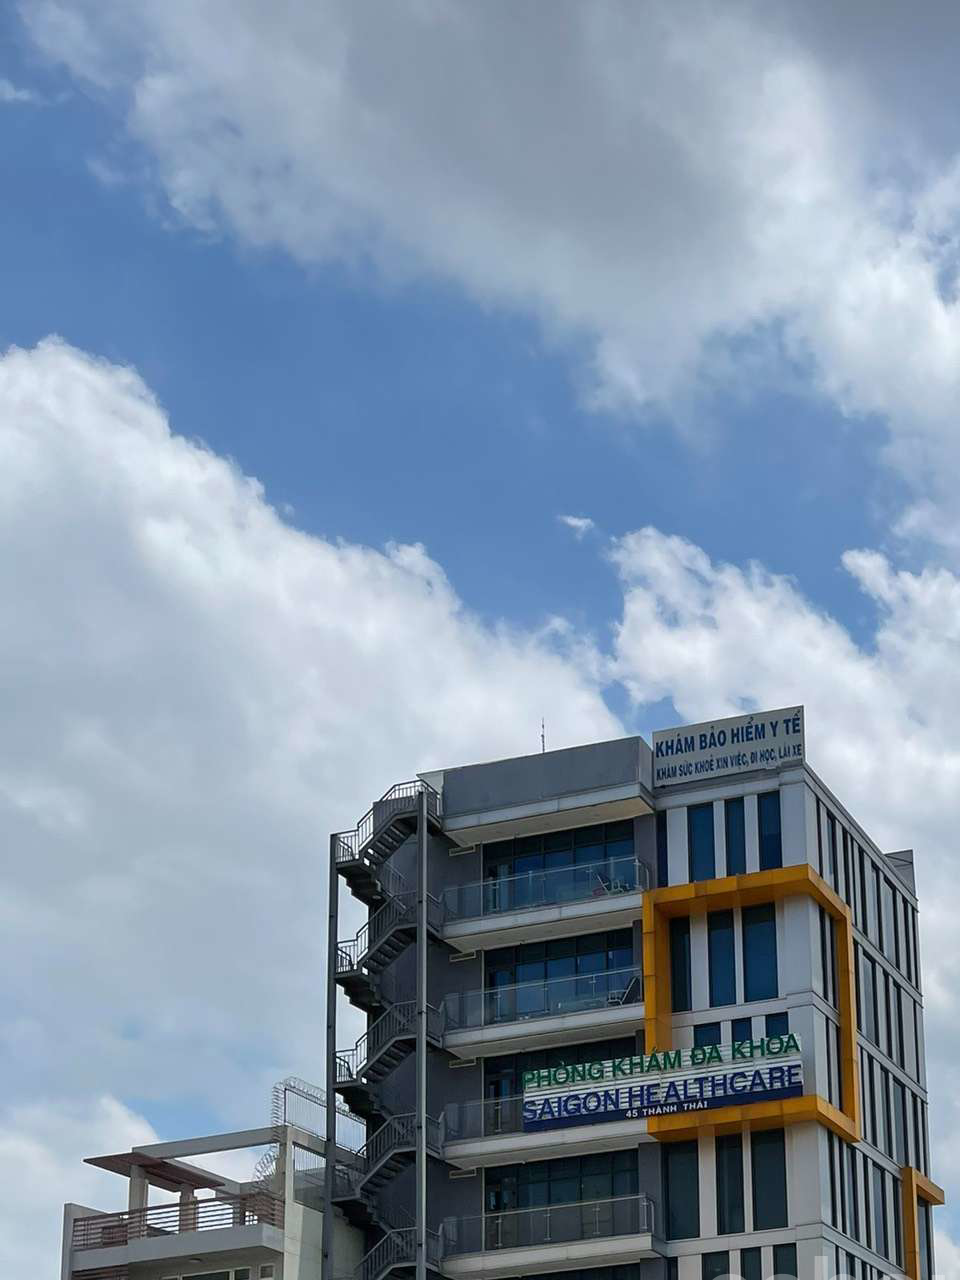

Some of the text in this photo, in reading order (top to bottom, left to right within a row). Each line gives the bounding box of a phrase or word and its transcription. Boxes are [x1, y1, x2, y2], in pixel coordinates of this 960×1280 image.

[655, 709, 801, 758] KHÁM BẢO HIỂM Y TẾ
[716, 756, 728, 770] XIN
[522, 1033, 801, 1090] PHÒNG KHÁM ĐA KHOA
[523, 1064, 803, 1121] SAIGON HEALTHCARE
[626, 1109, 638, 1118] 45
